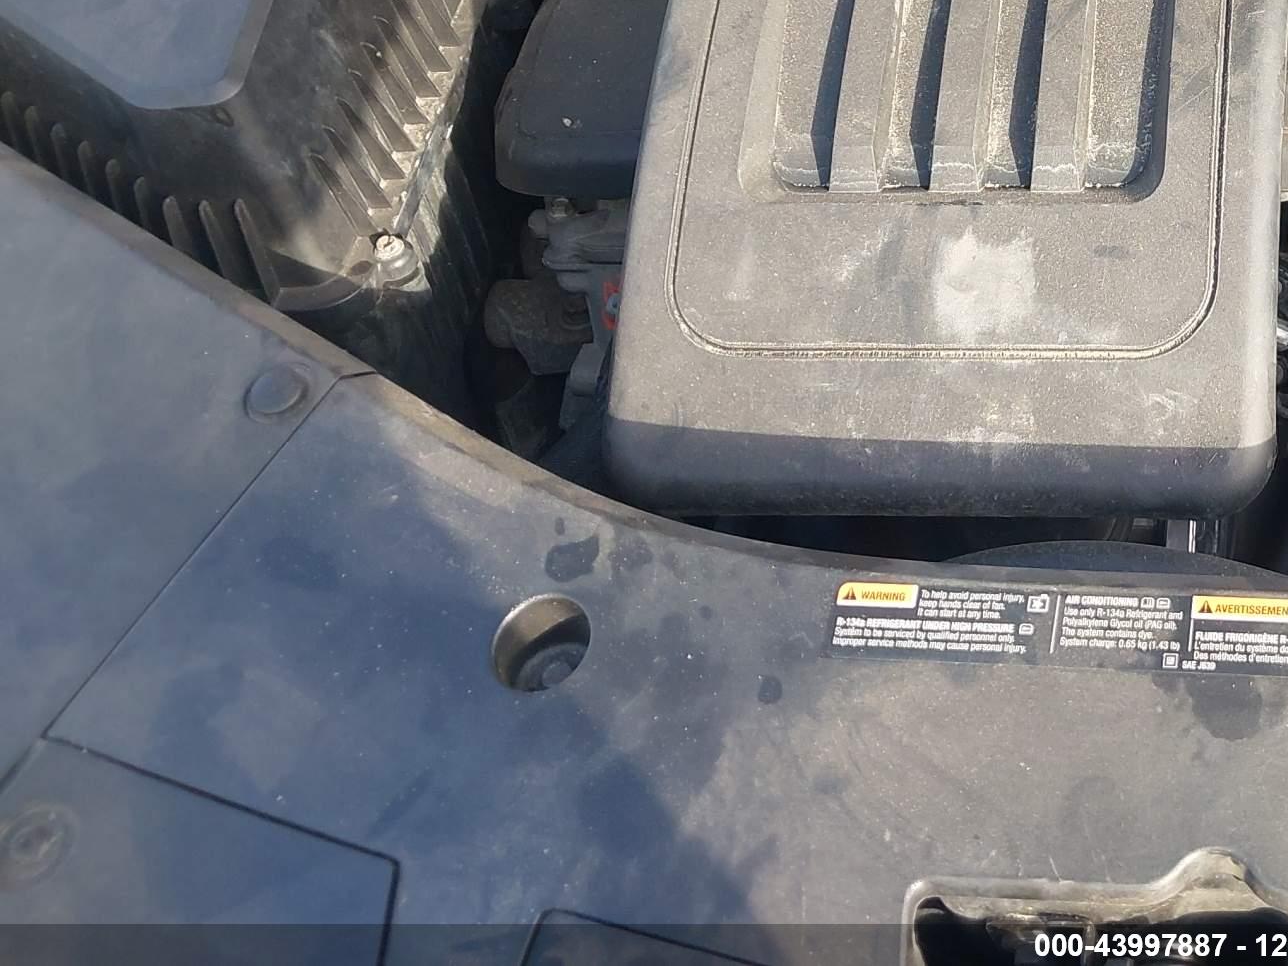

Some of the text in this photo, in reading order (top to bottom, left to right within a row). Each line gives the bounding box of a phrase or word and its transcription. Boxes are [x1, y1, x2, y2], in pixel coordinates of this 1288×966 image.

[861, 590, 906, 601] WARNING
[921, 589, 930, 598] To
[930, 590, 947, 600] help
[948, 591, 969, 600] avoid
[969, 592, 1001, 602] personal
[1064, 594, 1139, 607] AIR CONDITIONING
[918, 598, 1006, 610] keep hands clear of fan.
[939, 610, 957, 618] start
[957, 610, 966, 618] at
[966, 611, 981, 620] any
[982, 611, 1001, 619] time.
[1064, 606, 1184, 621] Use only R-134a Refrigerant and
[836, 616, 1015, 633] R-134a REFRIGERANT UNDER HIGH PRESSURE
[1062, 616, 1178, 631] Polyalkylene Glycol oil (PAG oil).
[834, 626, 862, 637] System
[863, 628, 872, 637] to
[872, 628, 883, 637] be
[883, 629, 915, 638] serviced
[916, 630, 926, 640] by
[927, 631, 960, 641] qualified
[998, 634, 1015, 644] only.
[1061, 626, 1154, 640] The system contains dye.
[1195, 631, 1224, 642] FLUIDE
[832, 636, 866, 647] Improper
[867, 638, 895, 647] service
[895, 639, 928, 648] methods
[928, 641, 946, 651] may
[946, 642, 970, 651] cause
[970, 643, 1003, 652] personal
[1059, 636, 1088, 647] System
[1088, 637, 1117, 649] charge:
[1137, 639, 1148, 651] kg
[1169, 641, 1181, 652] lb)
[1194, 641, 1234, 652] L'entretien
[1234, 643, 1245, 652] du
[1246, 643, 1279, 654] système
[1193, 651, 1209, 660] Des
[1209, 652, 1247, 662] méthodes
[1248, 653, 1288, 664] d'entretien
[1181, 660, 1197, 670] SAE
